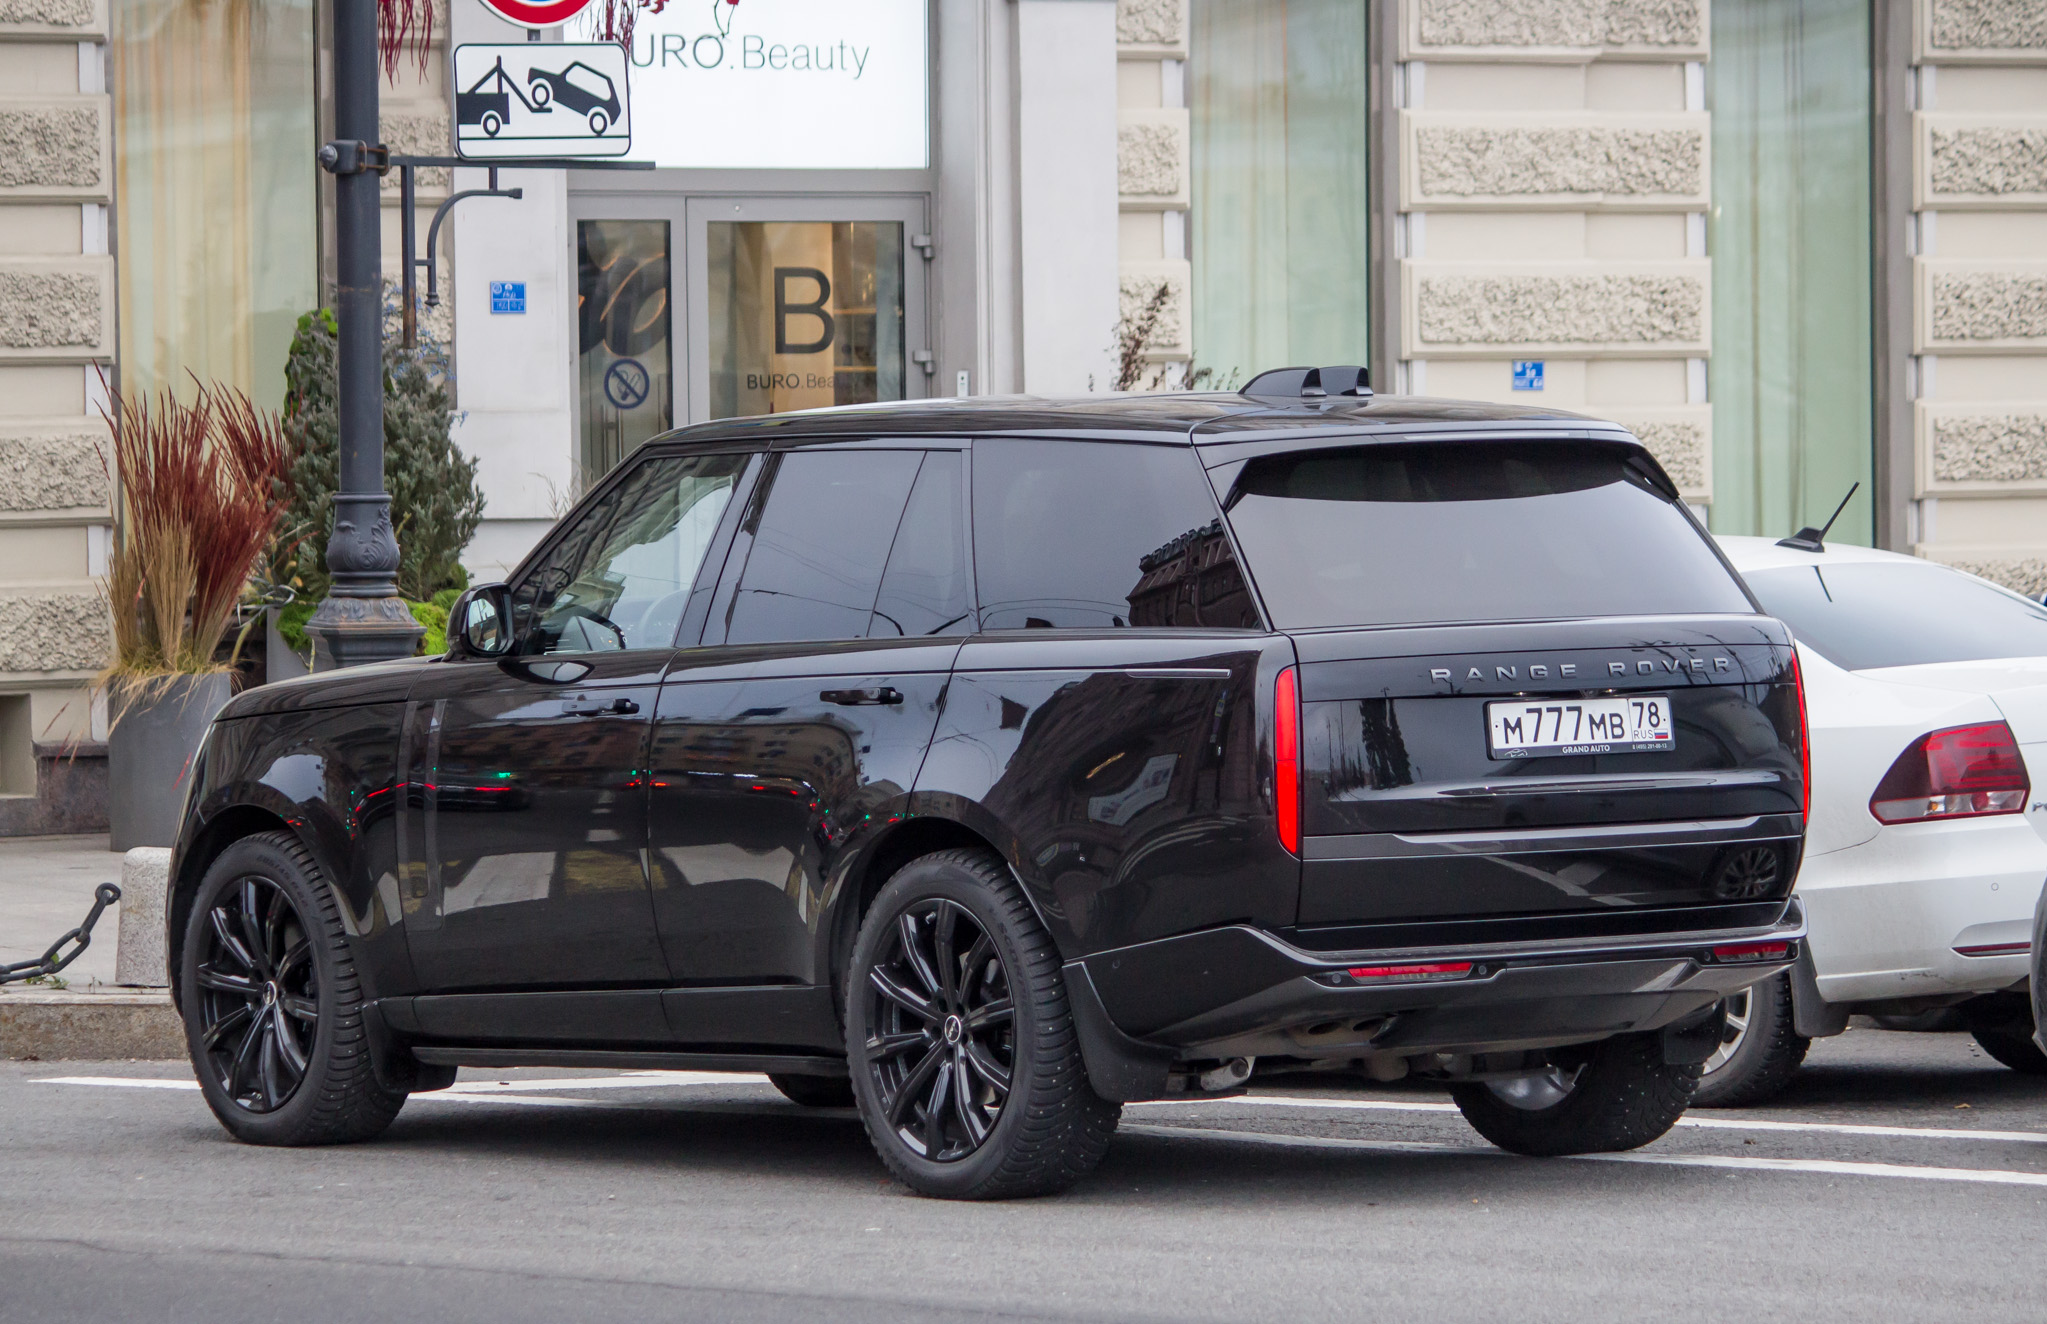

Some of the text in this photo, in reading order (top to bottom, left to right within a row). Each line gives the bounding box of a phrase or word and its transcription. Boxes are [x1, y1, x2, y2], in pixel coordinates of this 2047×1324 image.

[602, 33, 870, 80] URO.Beauty
[774, 267, 835, 354] B
[1430, 657, 1730, 683] RANGE ROVER
[1633, 730, 1654, 740] RUS
[1562, 744, 1611, 754] GRAND AUTO
